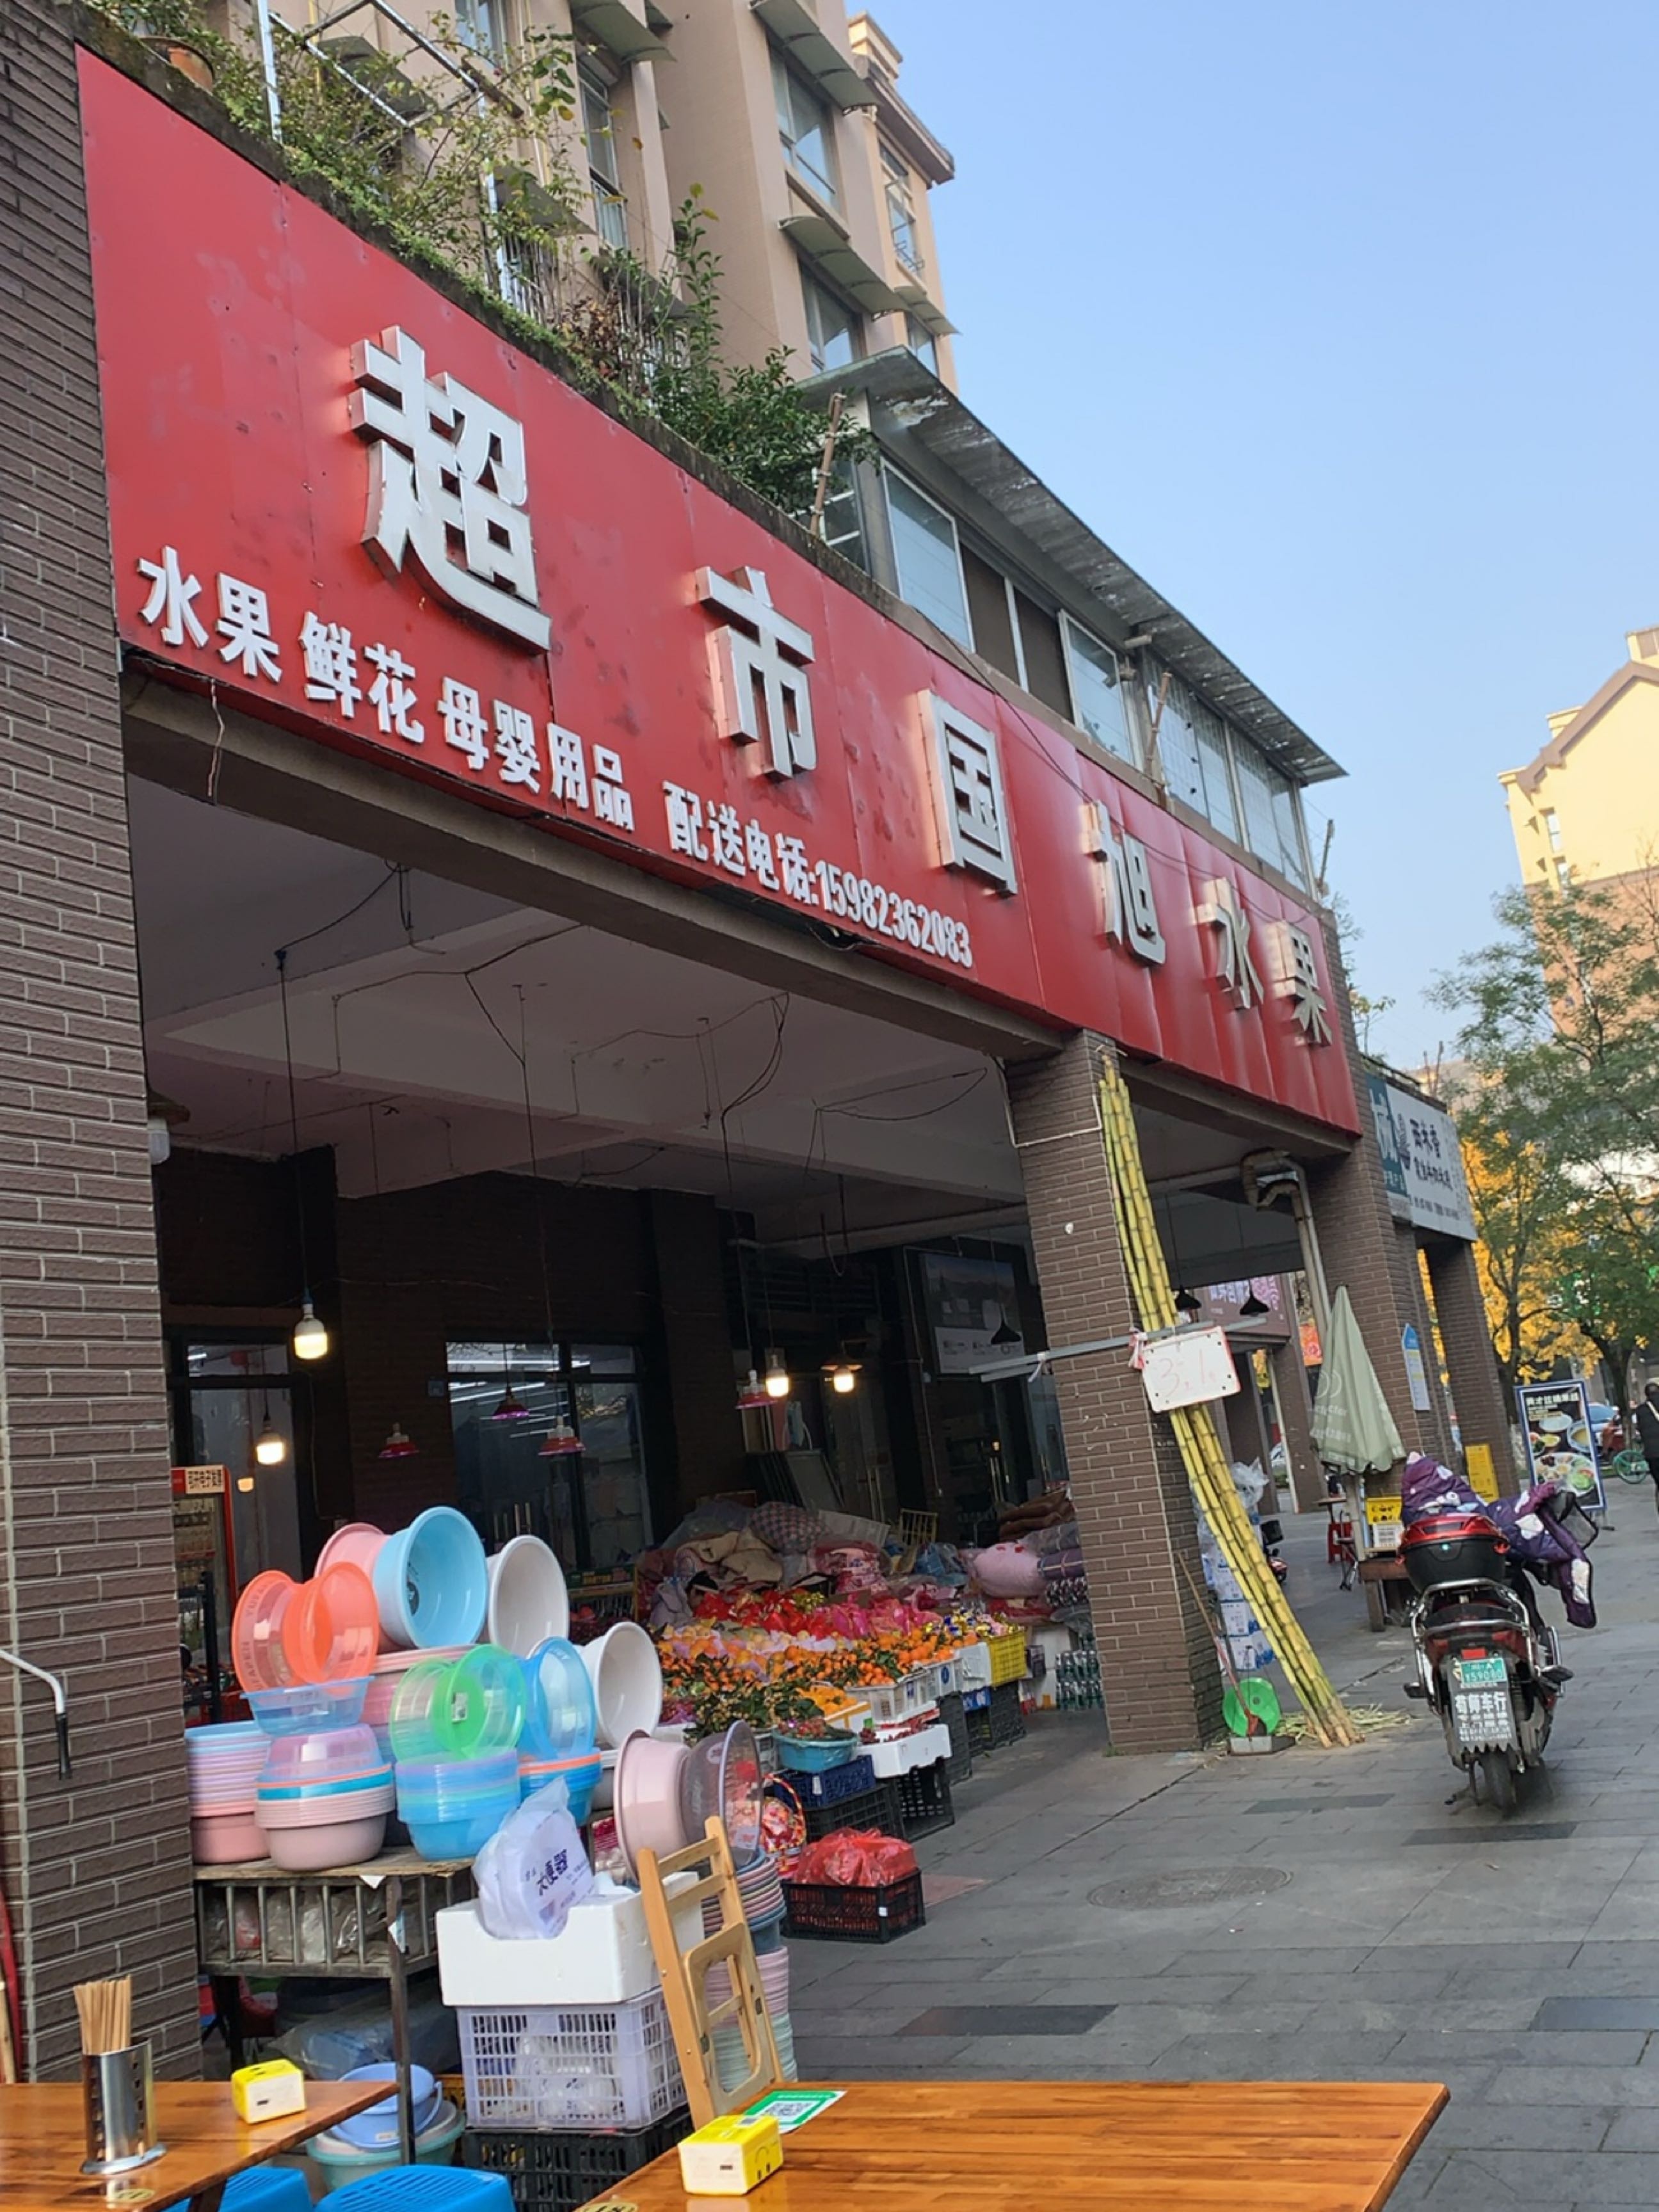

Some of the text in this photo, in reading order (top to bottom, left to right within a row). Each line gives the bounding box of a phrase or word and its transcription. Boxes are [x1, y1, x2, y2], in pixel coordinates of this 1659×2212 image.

[138, 545, 282, 682] 水果
[299, 611, 424, 744] 鲜花
[437, 676, 635, 831] 母婴用品
